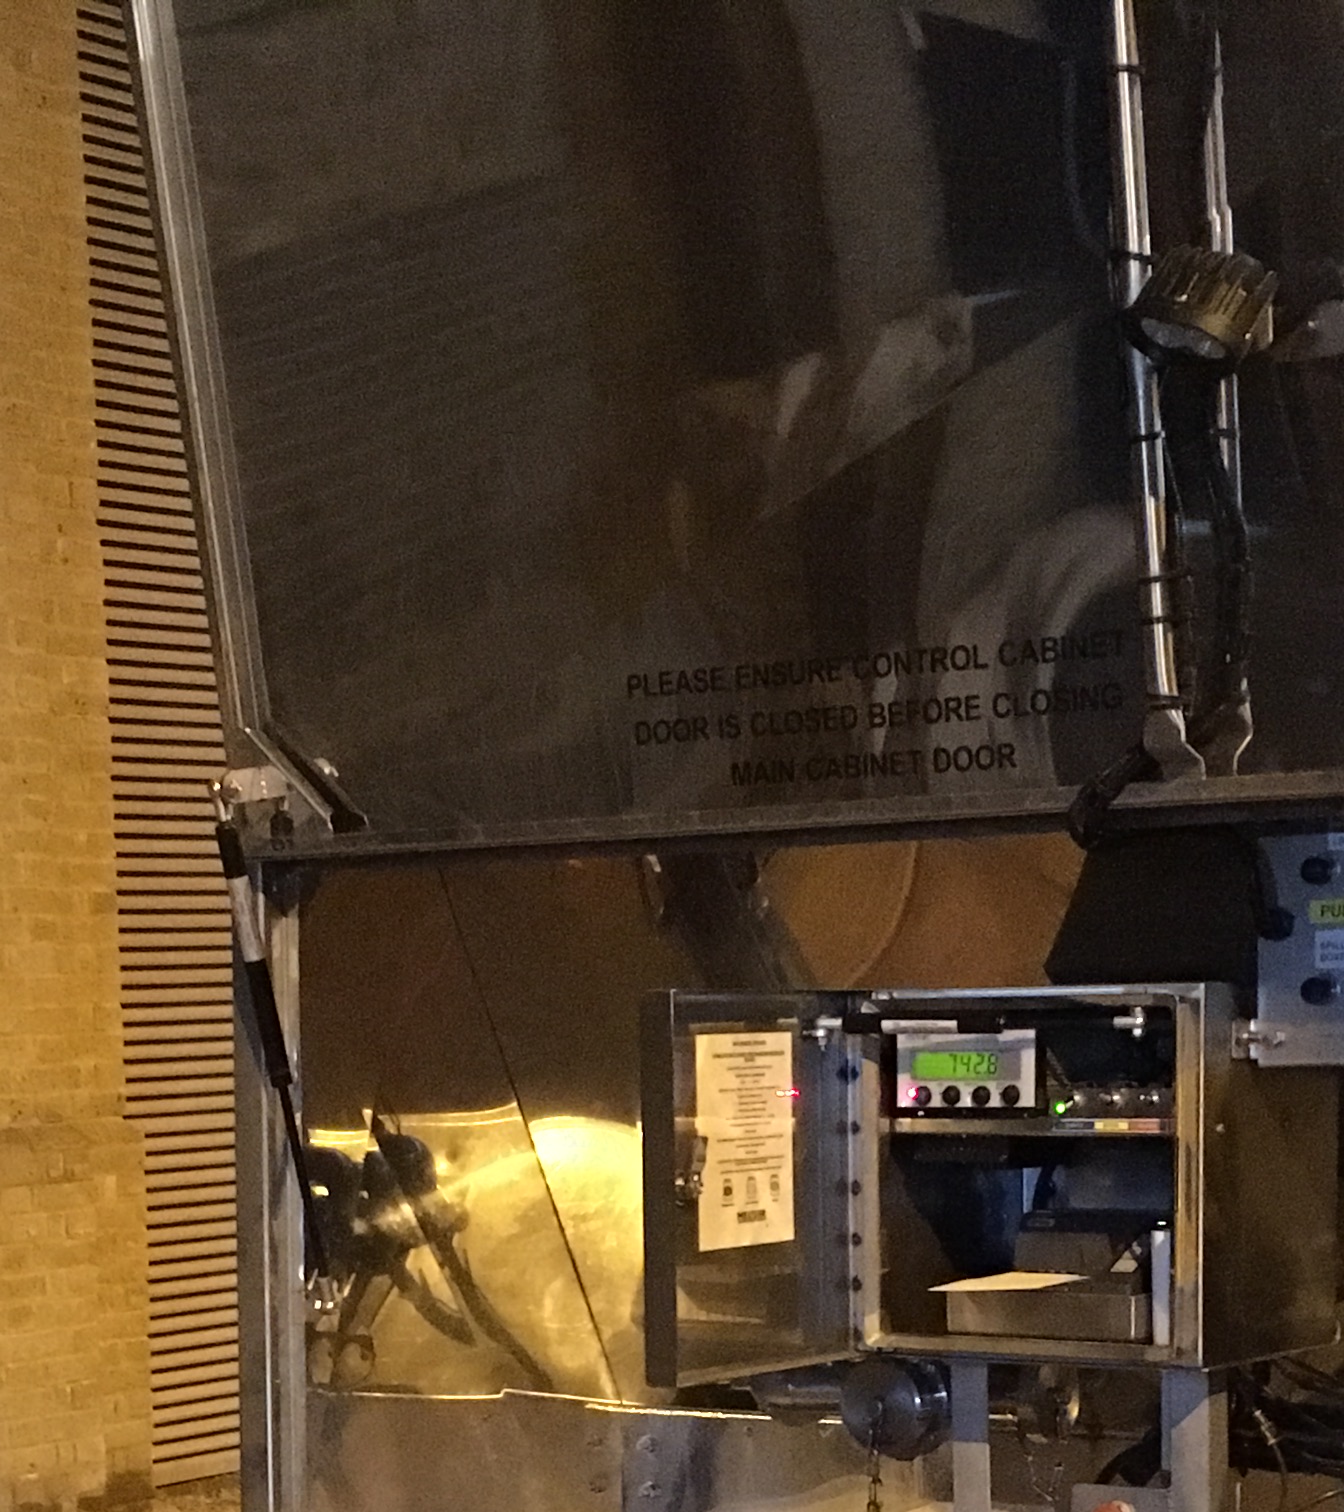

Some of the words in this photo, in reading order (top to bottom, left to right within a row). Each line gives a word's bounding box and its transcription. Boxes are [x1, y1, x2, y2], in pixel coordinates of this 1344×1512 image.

[626, 668, 726, 699] PLEASE
[735, 660, 841, 691] ENSURE
[852, 644, 989, 680] CONTROL
[997, 629, 1125, 666] CABINET
[634, 716, 710, 747] DOOR
[717, 713, 740, 740] IS
[749, 703, 858, 737] CLOSED
[867, 694, 981, 731] BEFORE
[991, 681, 1124, 720] CLOSING
[729, 757, 797, 788] MAIN
[804, 748, 923, 783] CABINET
[933, 742, 1018, 775] DOOR
